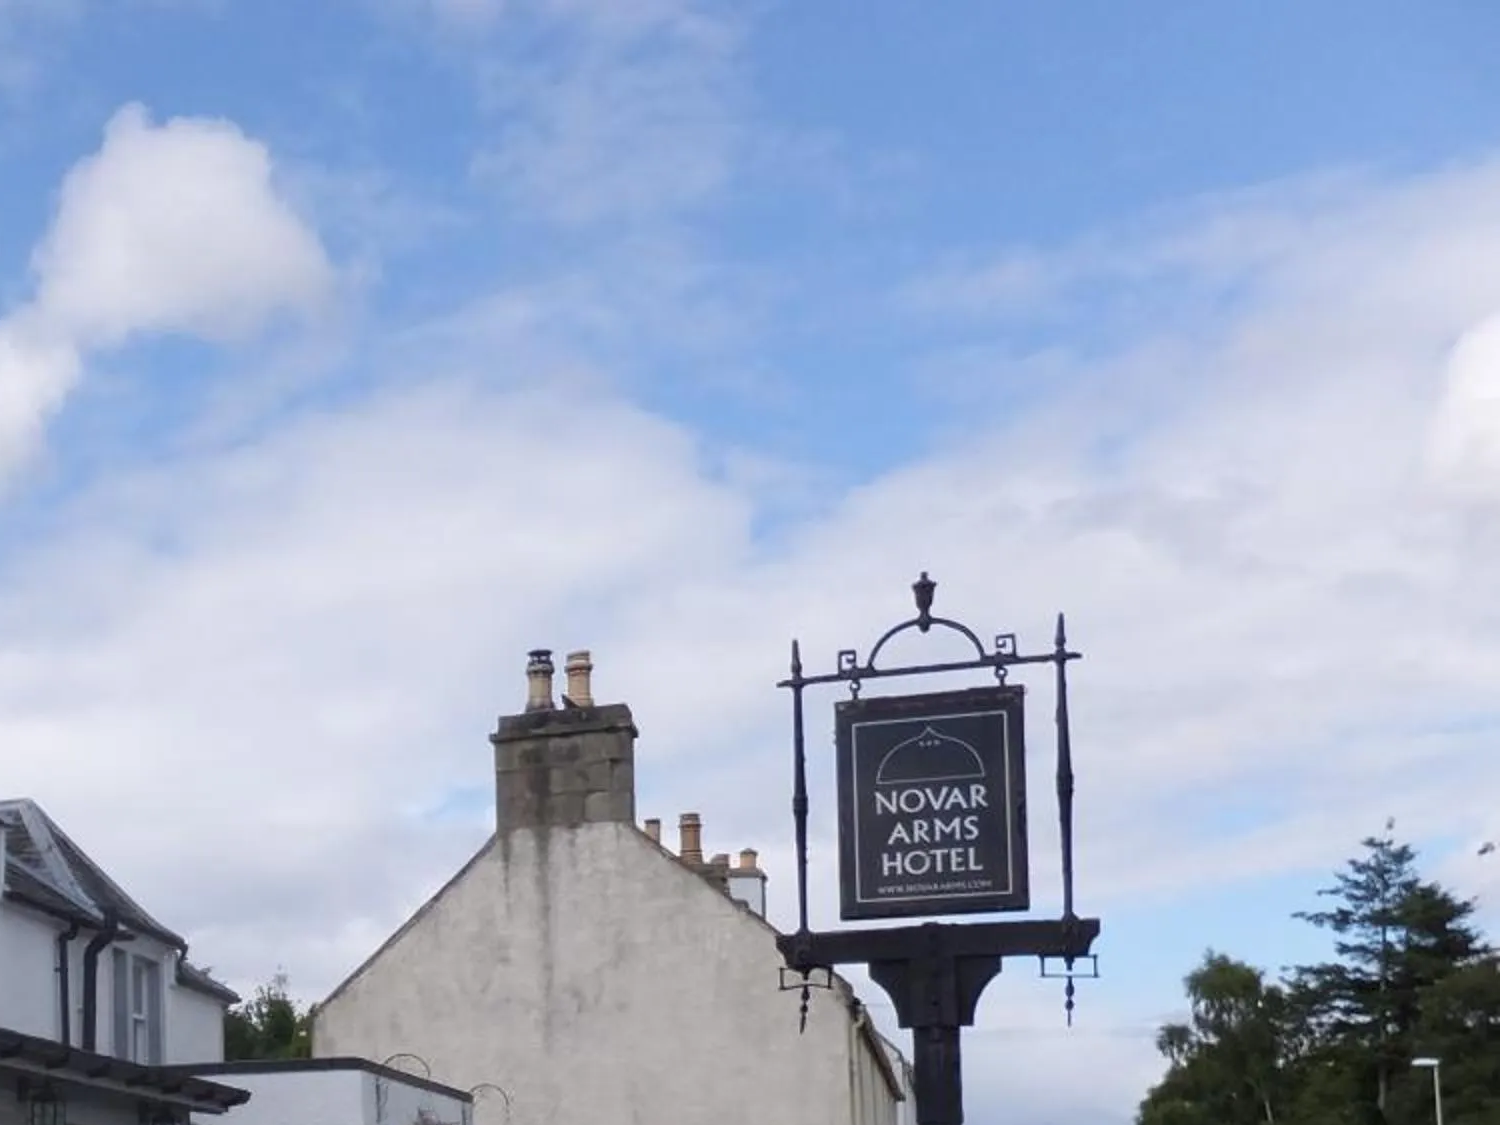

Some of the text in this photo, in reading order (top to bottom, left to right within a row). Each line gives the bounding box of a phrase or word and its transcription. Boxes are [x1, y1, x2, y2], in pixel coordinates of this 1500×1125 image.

[875, 784, 988, 815] NOVAR
[887, 816, 979, 845] ARMS
[882, 848, 983, 876] HOTEL
